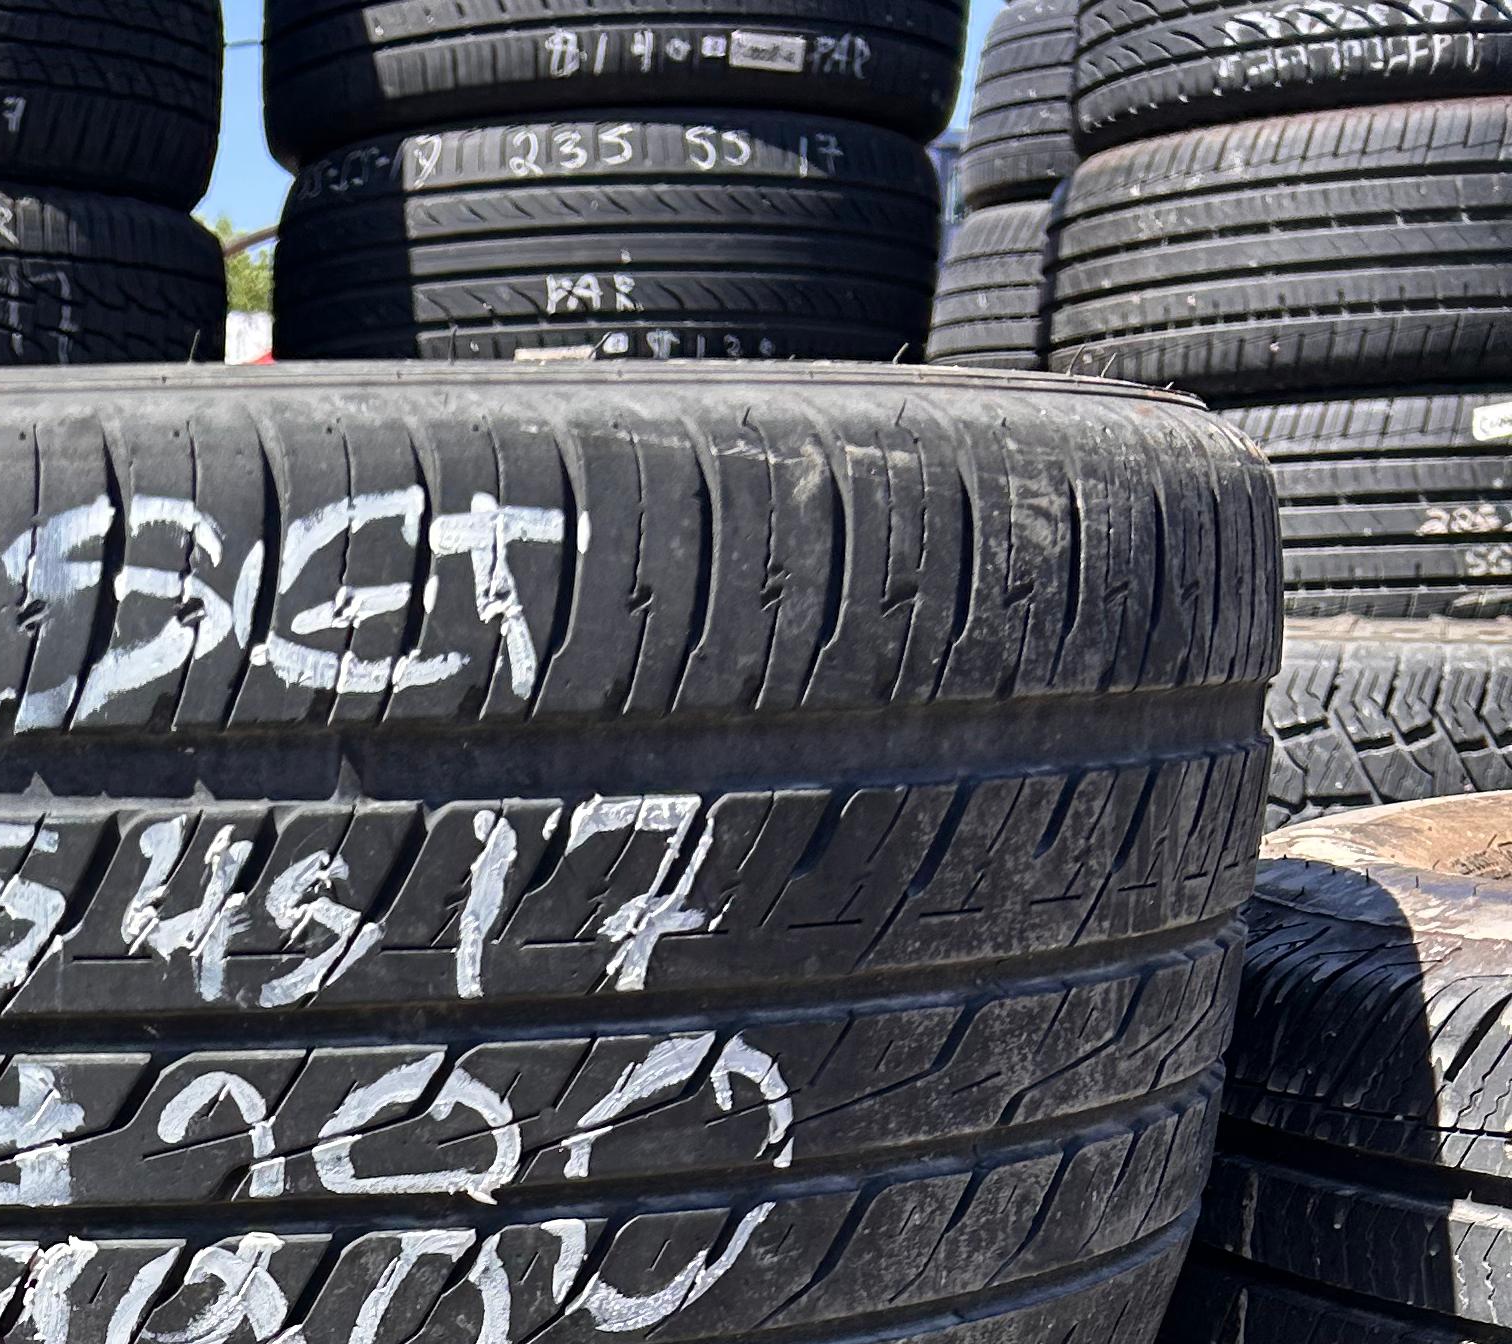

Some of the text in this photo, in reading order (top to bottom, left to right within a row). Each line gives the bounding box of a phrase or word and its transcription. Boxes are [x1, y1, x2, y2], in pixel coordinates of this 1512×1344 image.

[508, 122, 843, 178] 235 55 17
[120, 813, 385, 1008] 45
[458, 792, 733, 1000] 17
